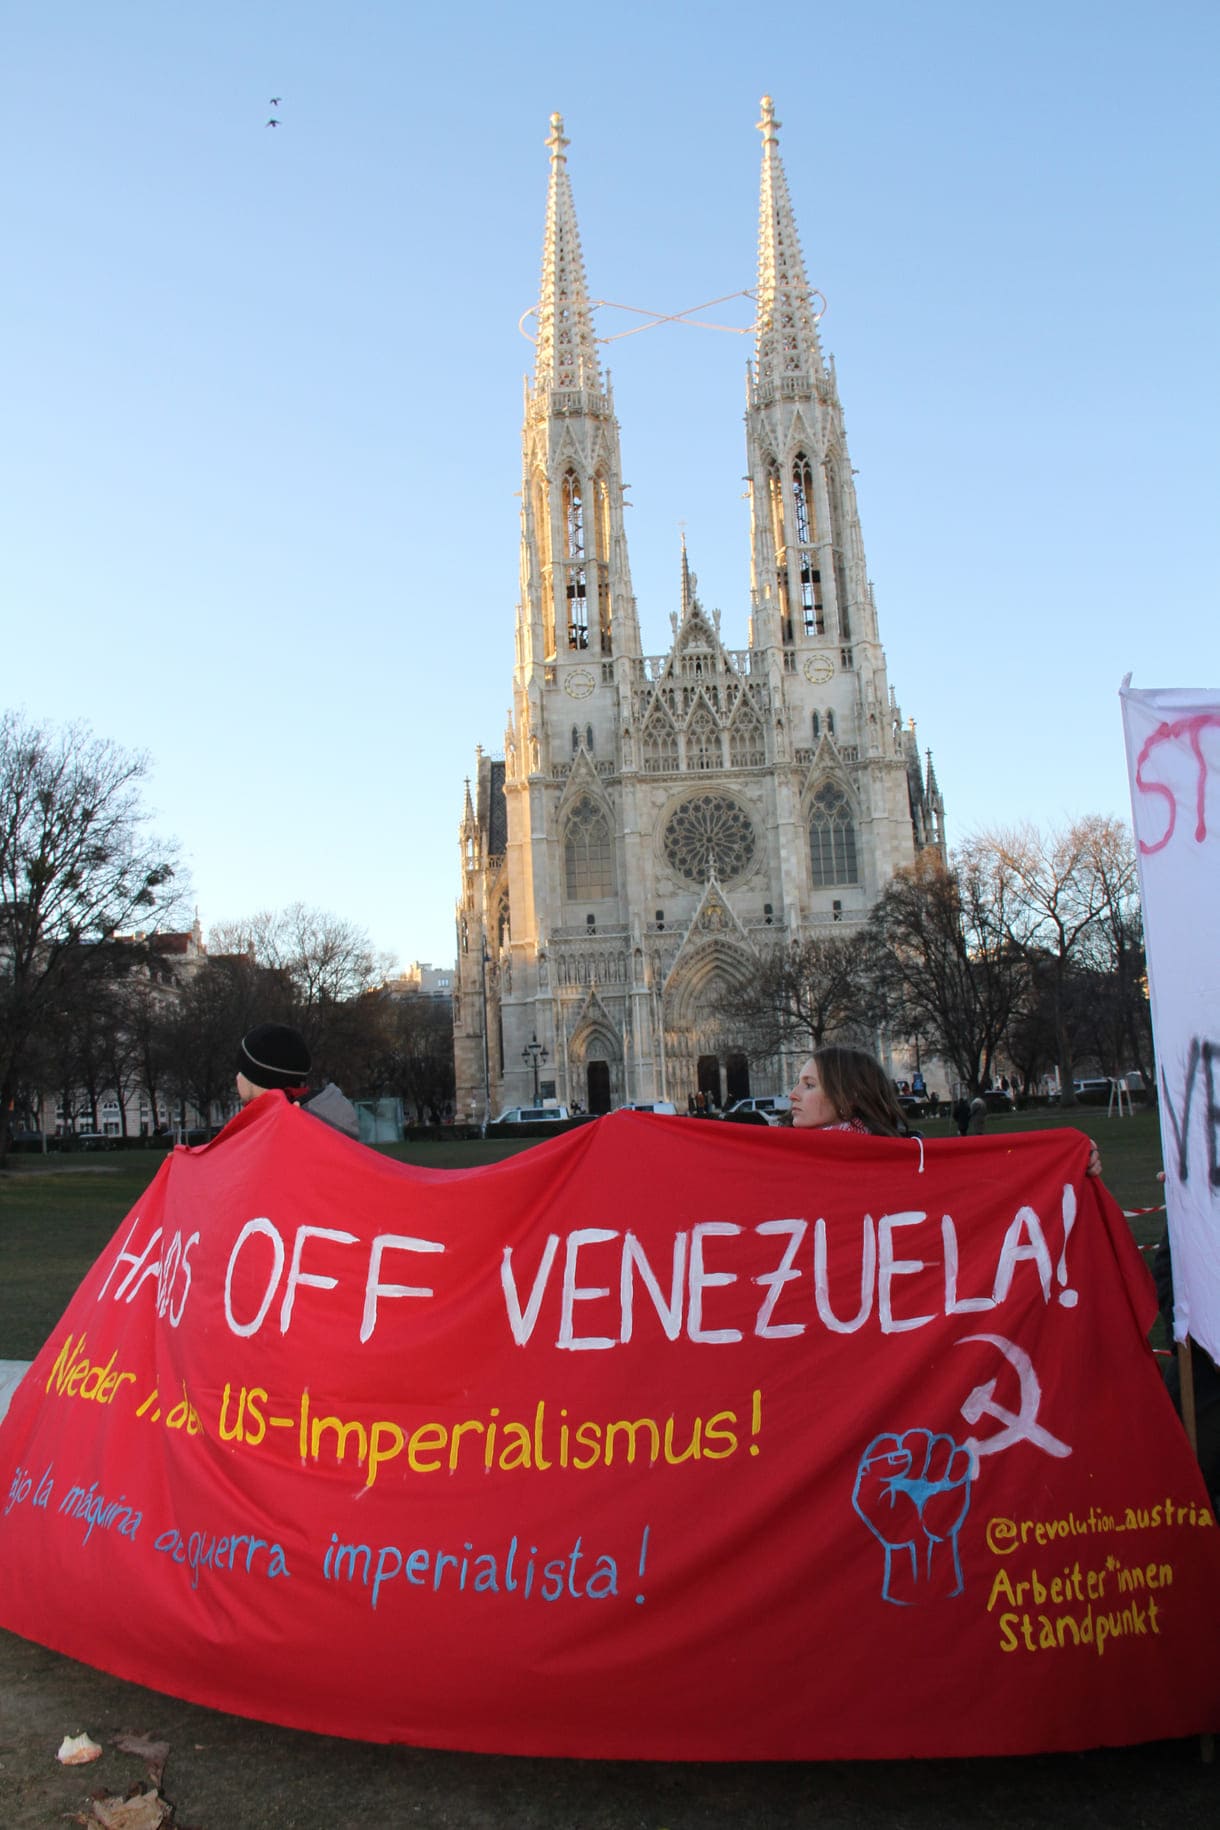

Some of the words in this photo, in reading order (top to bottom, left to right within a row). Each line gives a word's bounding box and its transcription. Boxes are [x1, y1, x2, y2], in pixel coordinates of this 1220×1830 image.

[224, 1217, 446, 1344] OFF
[500, 1184, 1079, 1351] VENEZUELA!
[218, 1383, 761, 1489] US-Imperialismus!
[188, 1530, 291, 1590] guerra
[324, 1525, 650, 1610] imperialista!
[986, 1498, 1214, 1555] @revolution_austria
[1000, 1596, 1161, 1656] Standpunkt
